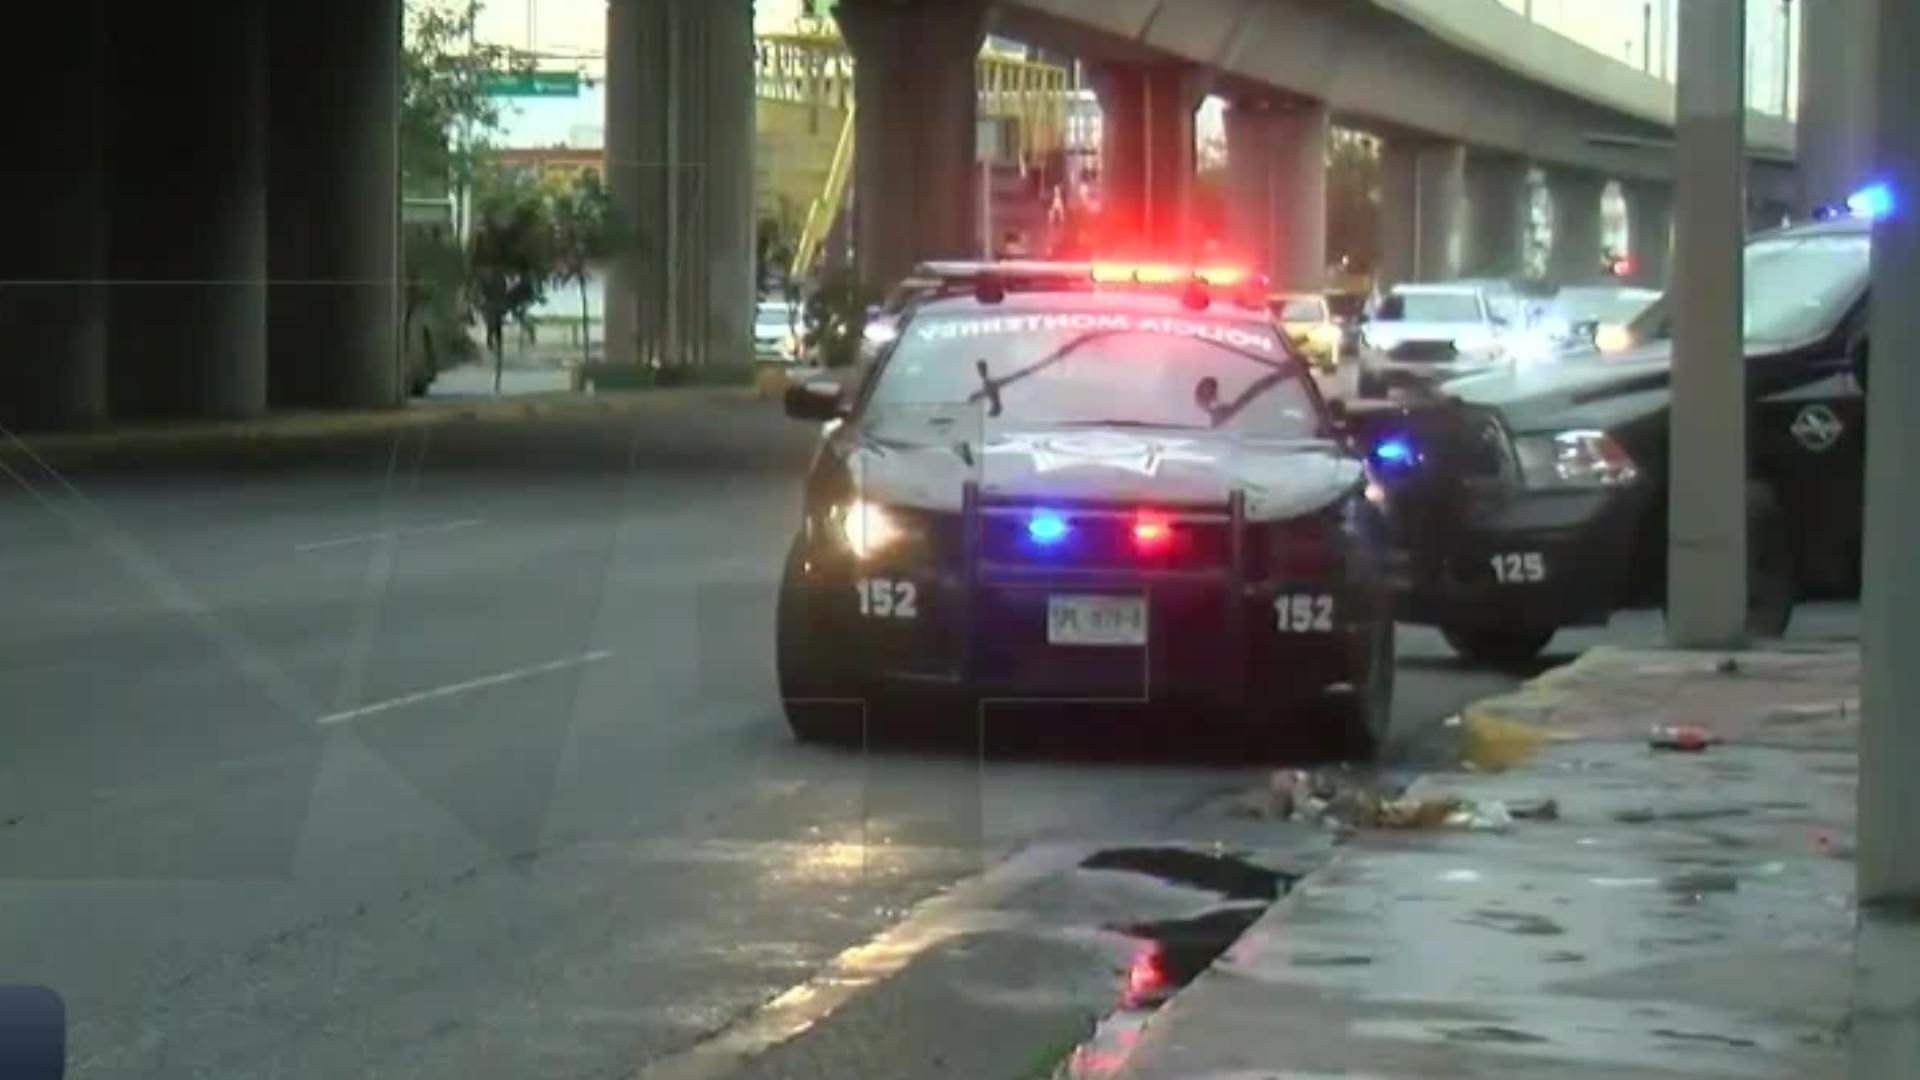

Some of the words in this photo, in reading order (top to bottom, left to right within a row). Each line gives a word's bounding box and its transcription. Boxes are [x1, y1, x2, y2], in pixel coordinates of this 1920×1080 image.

[1490, 553, 1545, 582] 125
[857, 579, 917, 616] 152
[1273, 595, 1334, 632] 152
